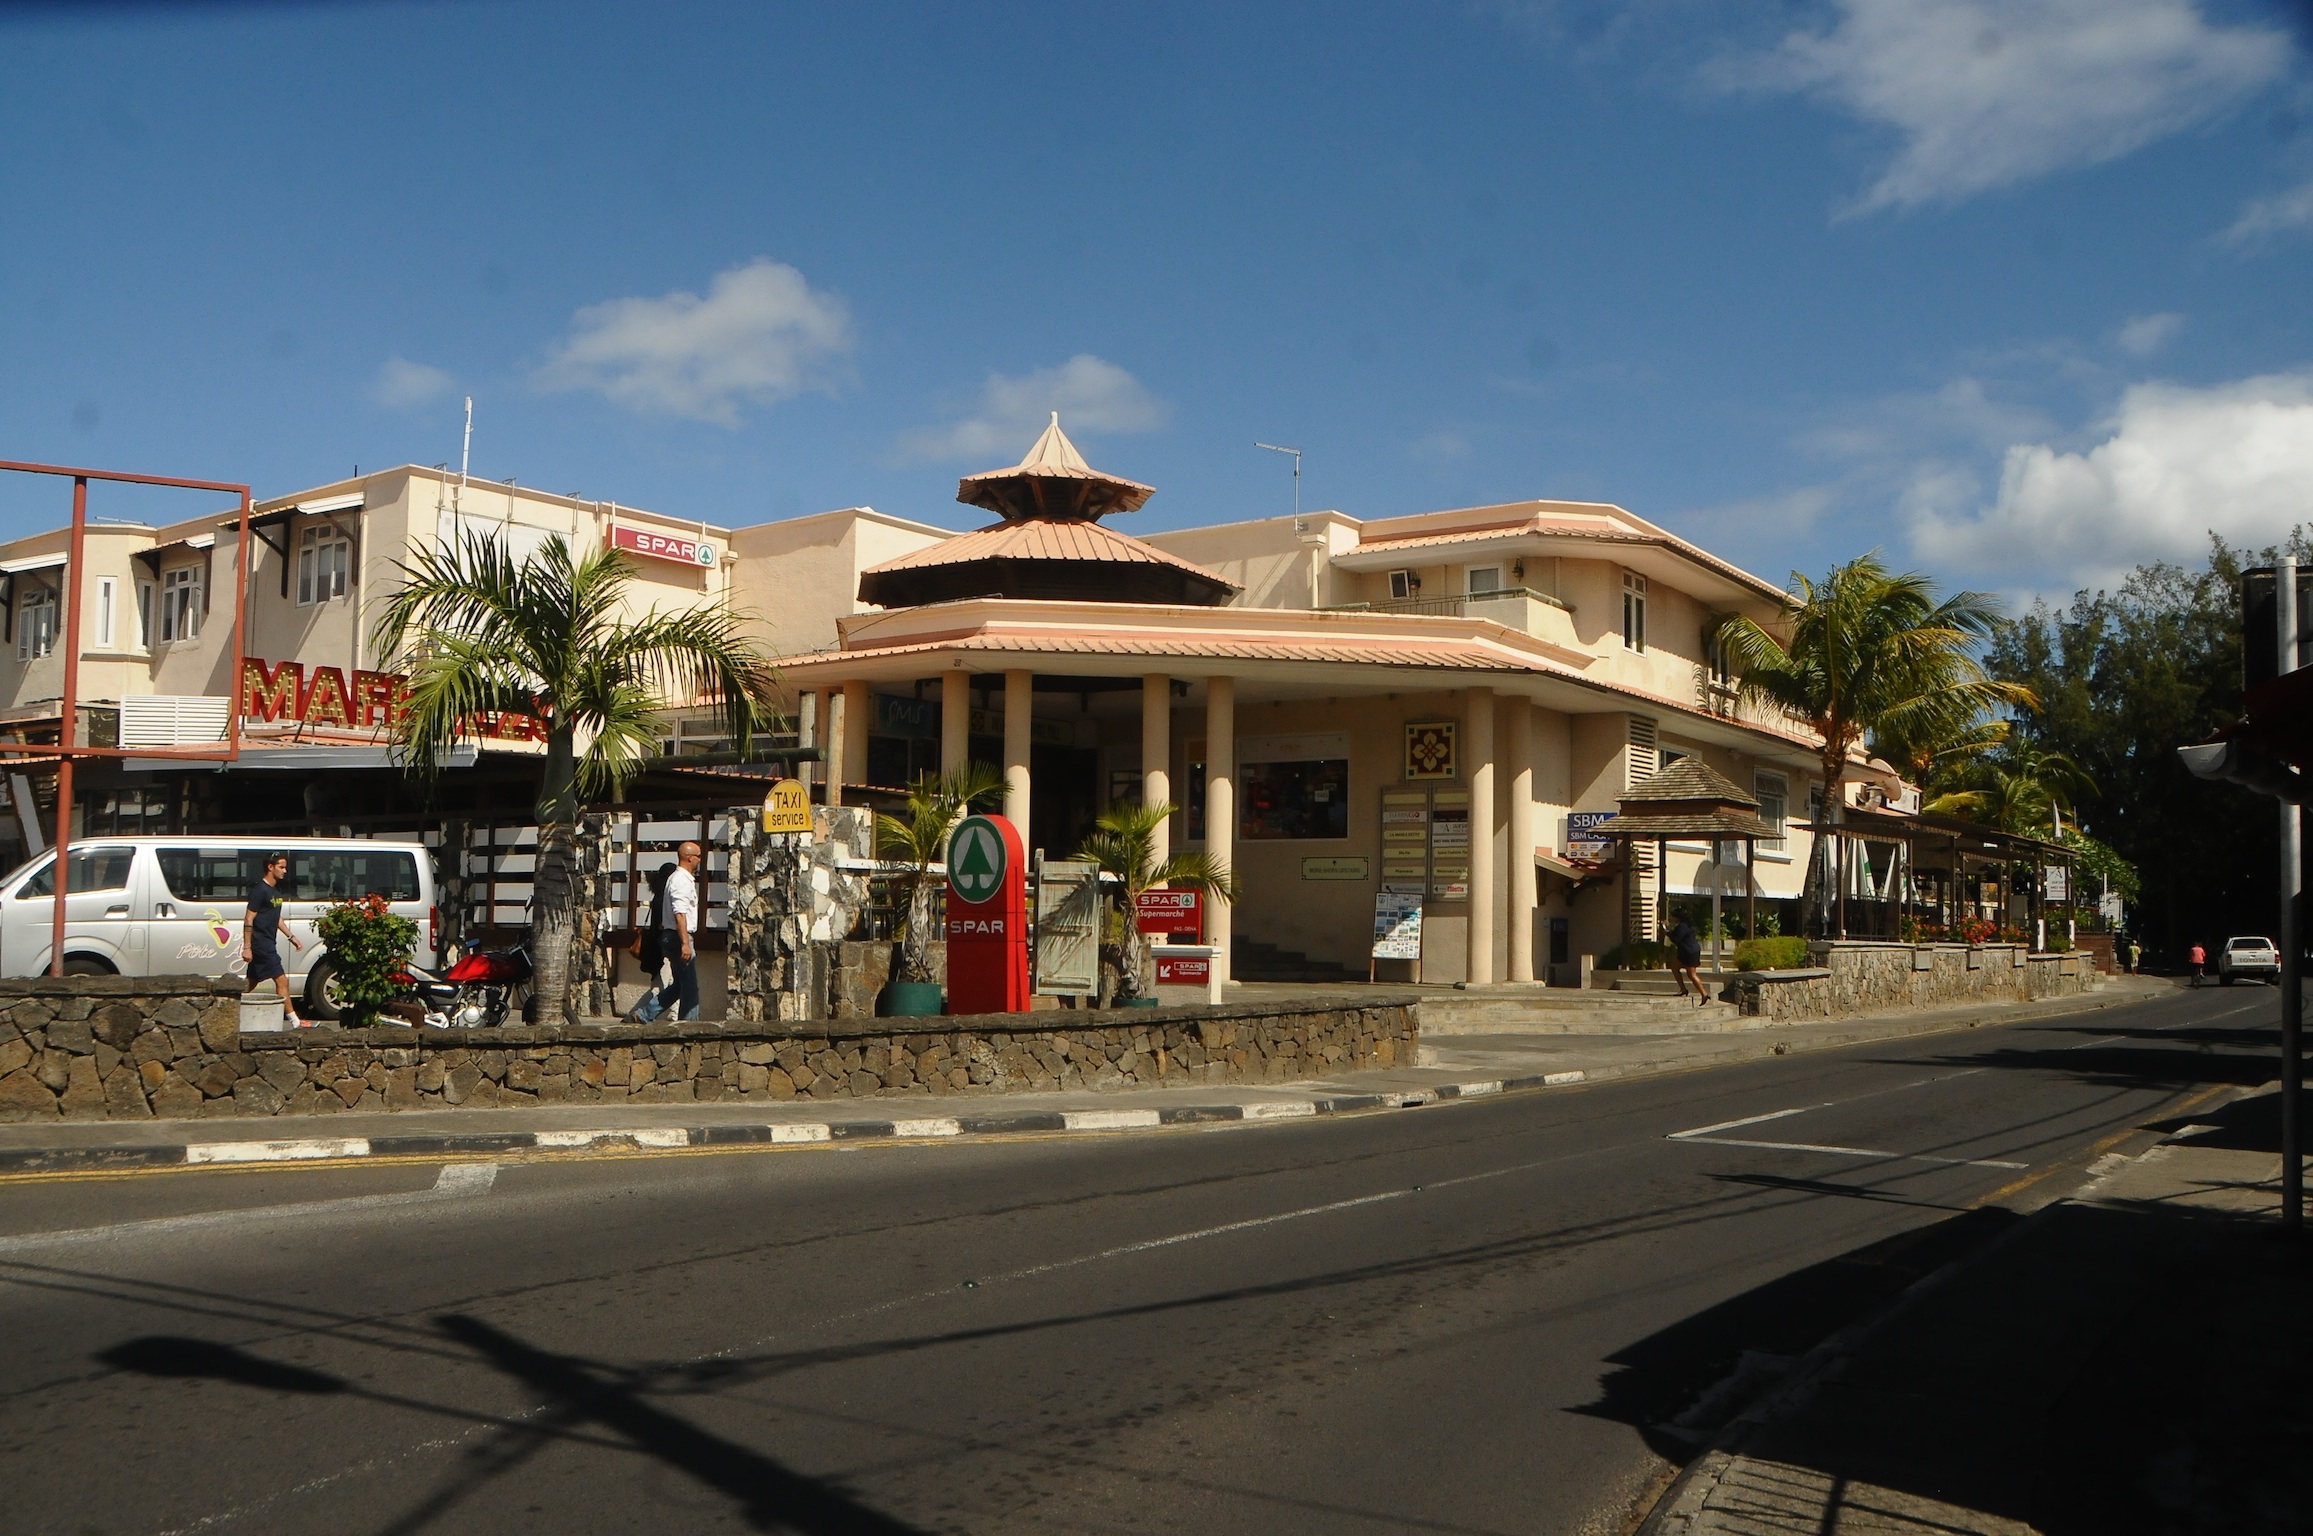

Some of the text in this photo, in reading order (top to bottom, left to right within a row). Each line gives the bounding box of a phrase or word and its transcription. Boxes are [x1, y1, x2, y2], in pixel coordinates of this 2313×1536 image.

[636, 534, 695, 559] SPAR
[774, 791, 802, 808] TAXI
[771, 813, 804, 826] service
[1573, 814, 1605, 828] SBM
[1570, 832, 1587, 840] SBM
[1140, 896, 1180, 905] SPAR
[1139, 908, 1185, 919] Supermarché
[950, 920, 1004, 934] SPAR
